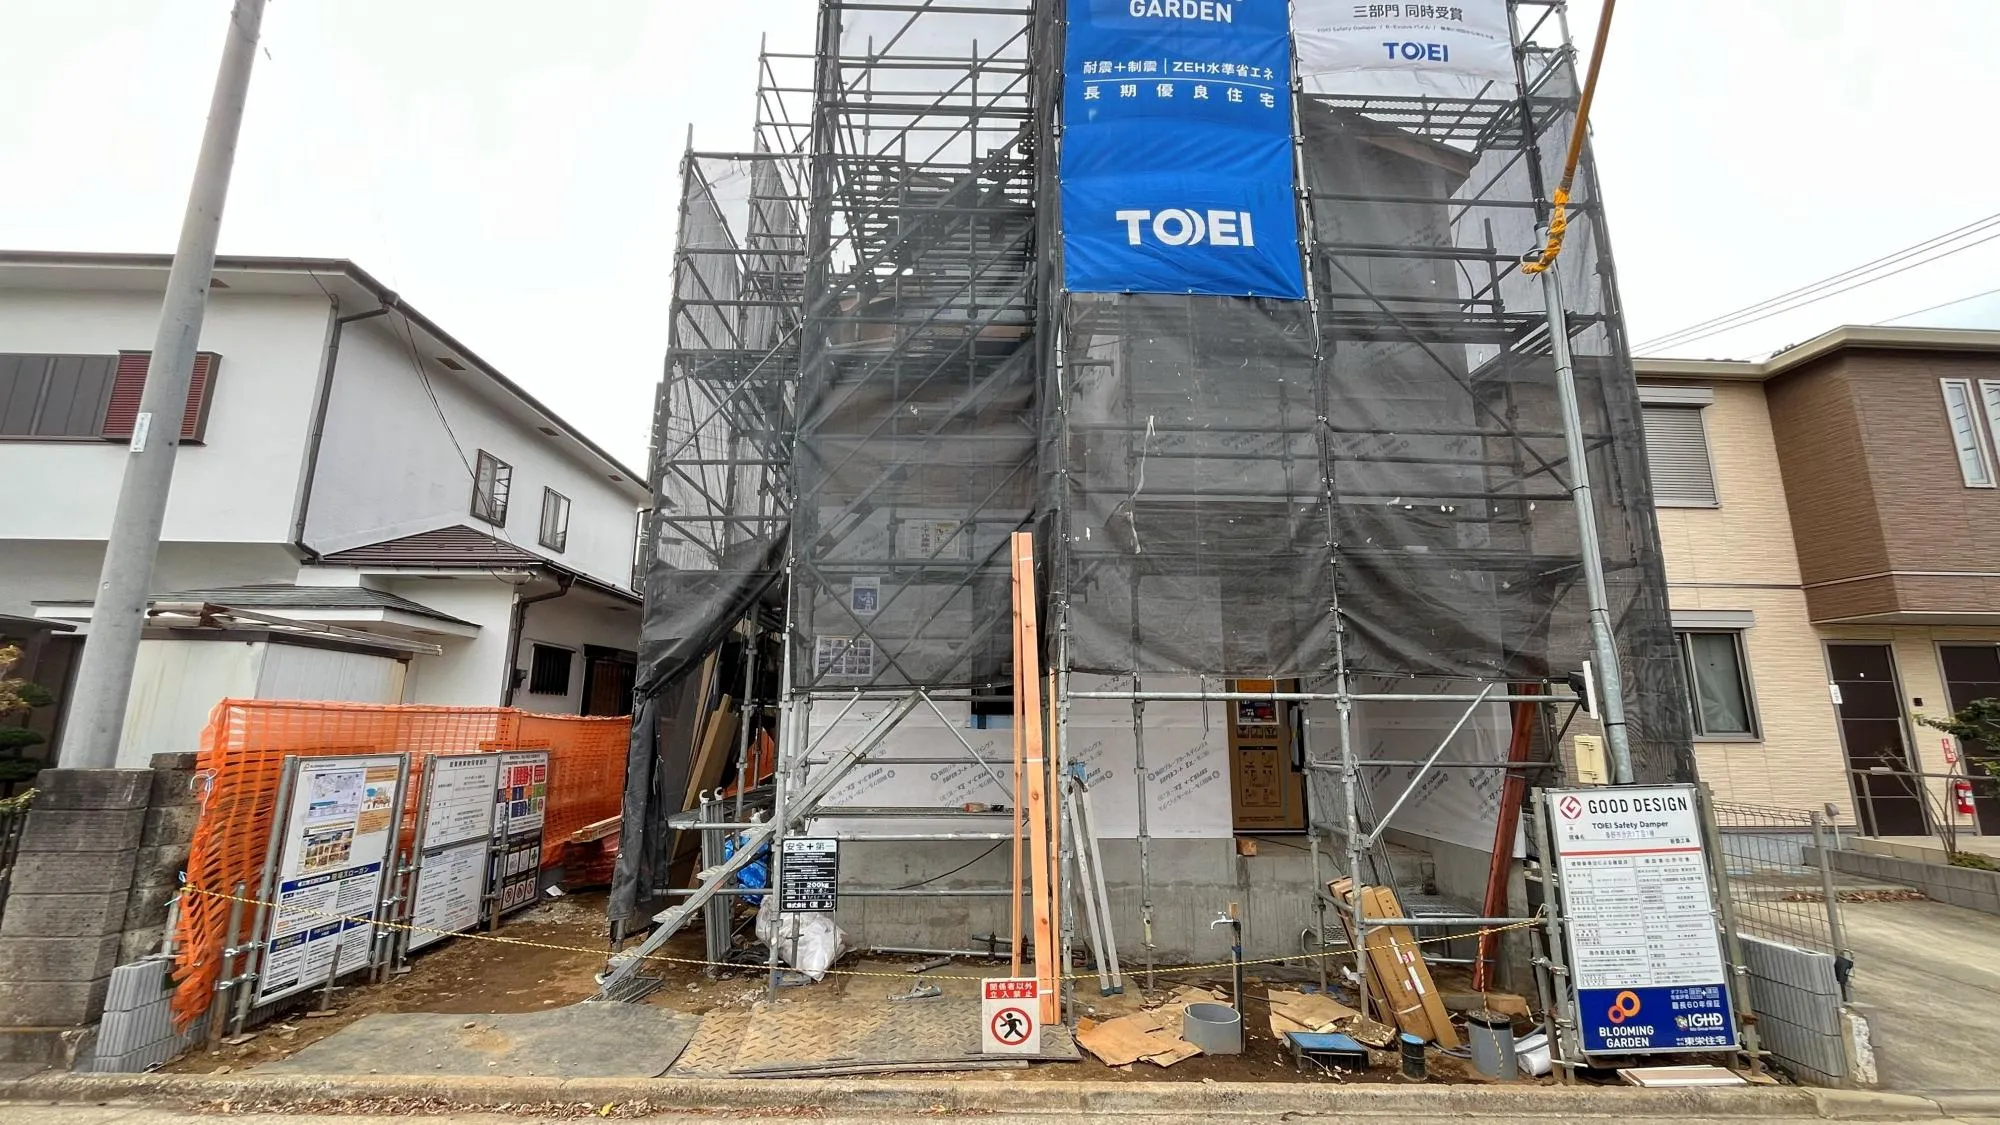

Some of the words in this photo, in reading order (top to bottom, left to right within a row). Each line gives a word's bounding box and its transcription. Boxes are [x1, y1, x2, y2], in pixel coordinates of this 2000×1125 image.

[1129, 0, 1232, 23] GARDEN
[1353, 5, 1400, 18] 三部門
[1405, 5, 1463, 22] 同時受賞
[1382, 42, 1449, 62] TOEI
[1172, 61, 1275, 80] ZEH水準省エネ
[1084, 84, 1275, 108] 長期優良住宅
[1115, 208, 1255, 247] TOEI
[1588, 799, 1629, 814] GOOD
[1632, 796, 1688, 812] DESIGN
[1592, 822, 1613, 830] TOEI
[1614, 821, 1638, 830] Safety
[1639, 821, 1669, 829] Damper
[989, 982, 1033, 991] 関係者以外
[989, 990, 1033, 998] 立入禁止
[1598, 1025, 1655, 1037] BLOOMING
[1606, 1037, 1650, 1048] GARDEN
[1684, 1036, 1727, 1046] 東栄住宅
